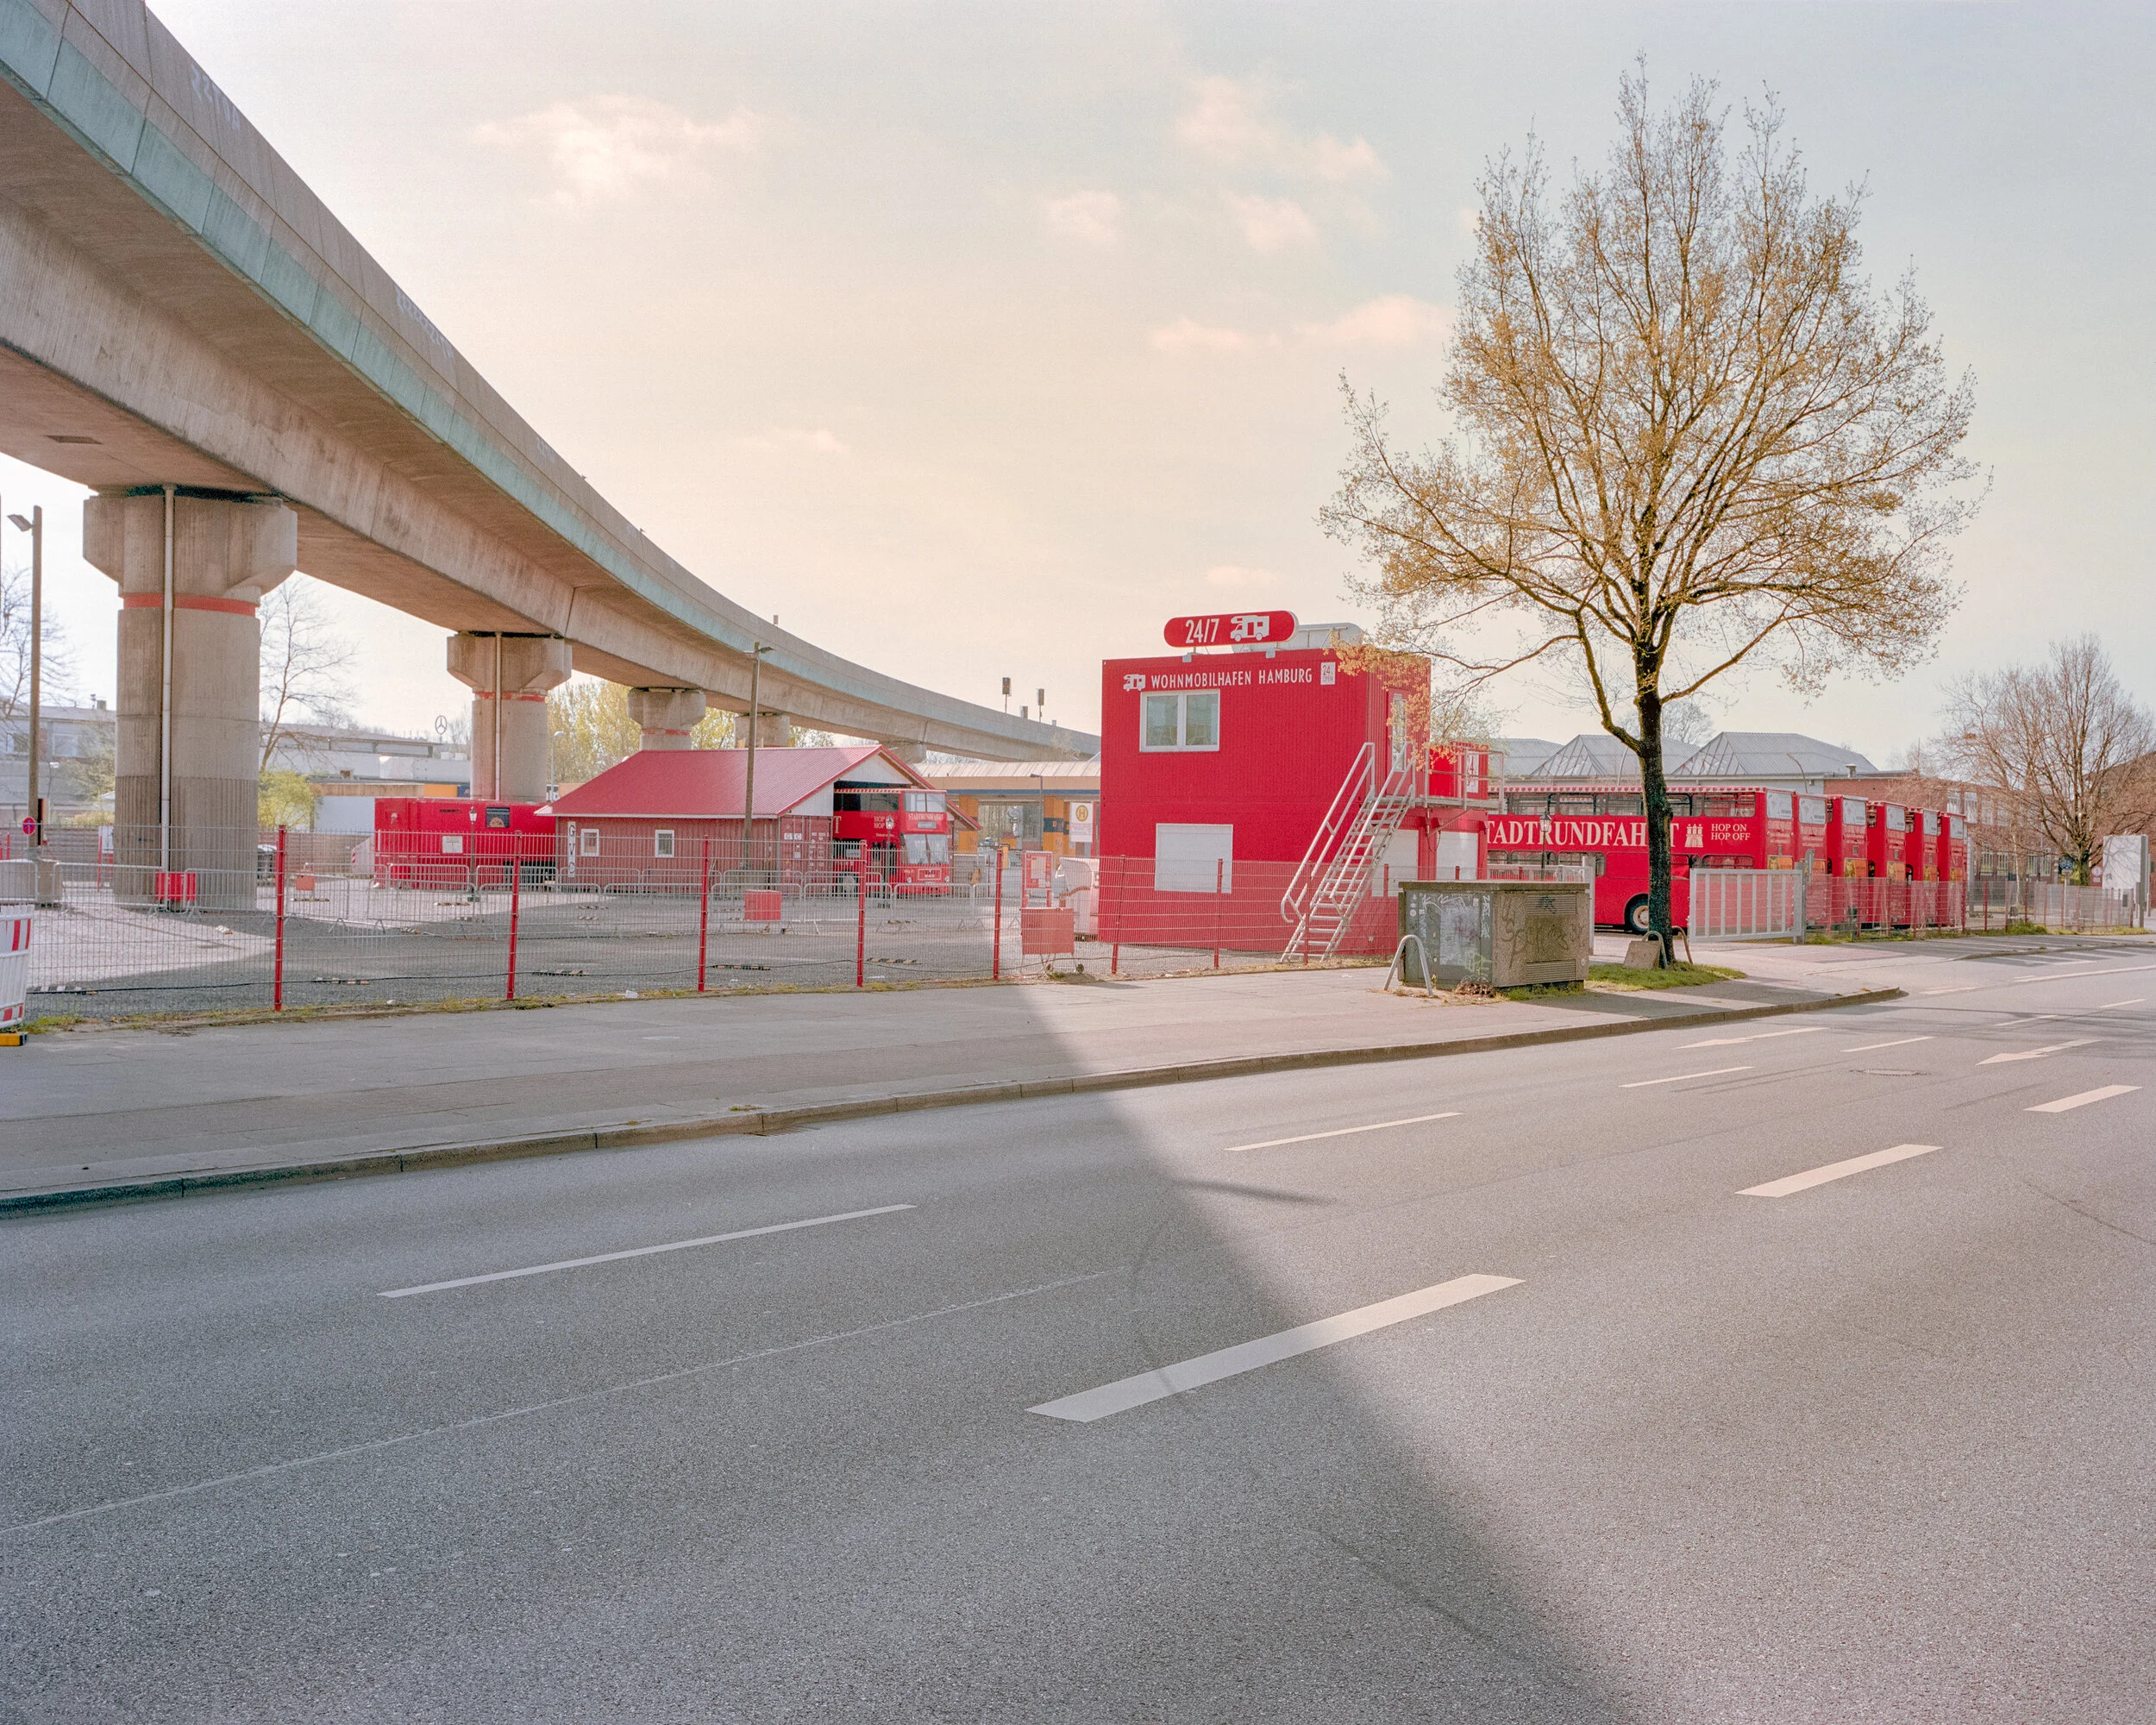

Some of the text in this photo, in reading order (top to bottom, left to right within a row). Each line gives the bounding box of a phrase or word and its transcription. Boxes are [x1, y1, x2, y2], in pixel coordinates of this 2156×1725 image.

[1185, 618, 1219, 643] 24/7
[1150, 668, 1313, 689] WOHNMOBILHAFEN HAMBURG
[1485, 820, 1680, 848] TADTRUNDFAHT
[1710, 823, 1747, 831] HOP ON
[1710, 831, 1751, 841] HOP OFF
